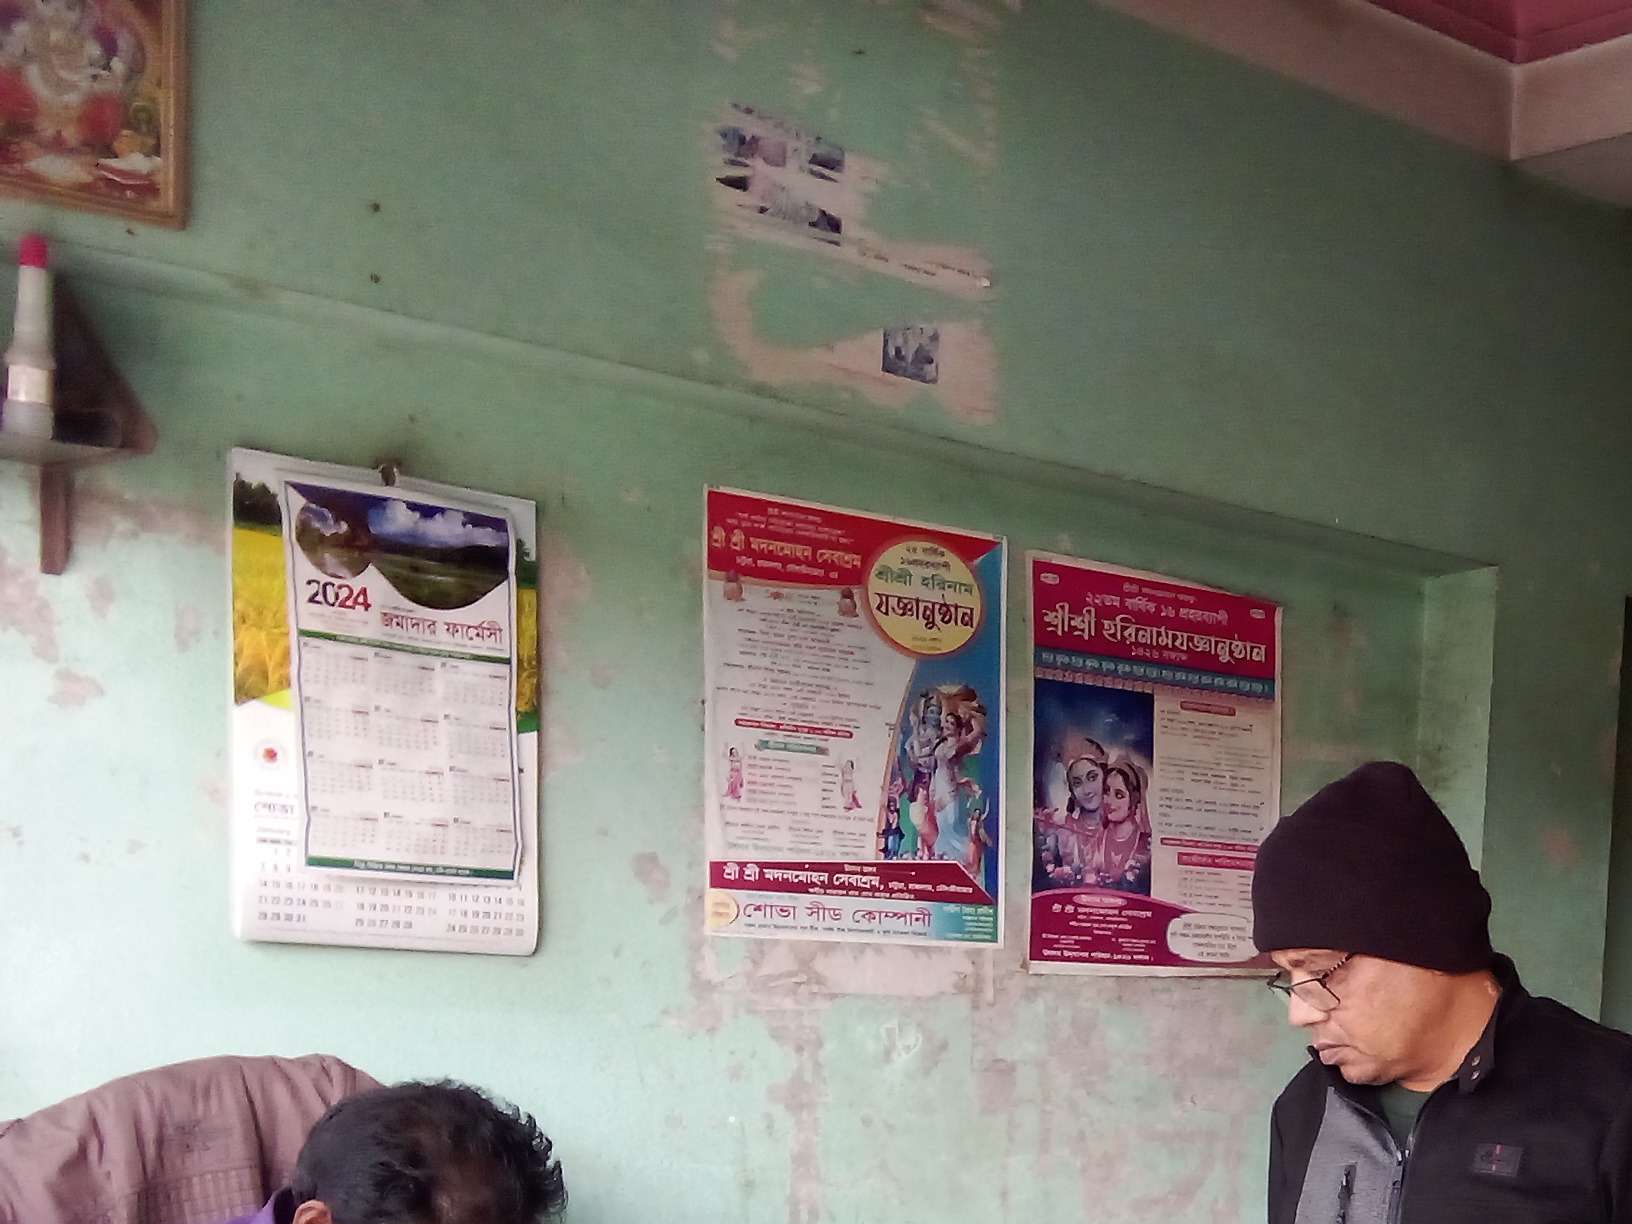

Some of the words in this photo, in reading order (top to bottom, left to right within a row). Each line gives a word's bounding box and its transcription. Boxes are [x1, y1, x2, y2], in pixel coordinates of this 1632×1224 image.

[306, 579, 372, 612] 2024
[874, 592, 974, 632] যজ্ঞানুষ্ঠান
[380, 611, 438, 636] জমাদার
[443, 619, 504, 644] ফার্মেসী
[1042, 602, 1097, 640] শ্রীশ্রী
[723, 862, 738, 880] শ্রী
[743, 863, 759, 882] শ্রী
[743, 902, 796, 921] শোভা
[806, 901, 842, 923] সীড
[853, 902, 932, 928] কোম্পানী
